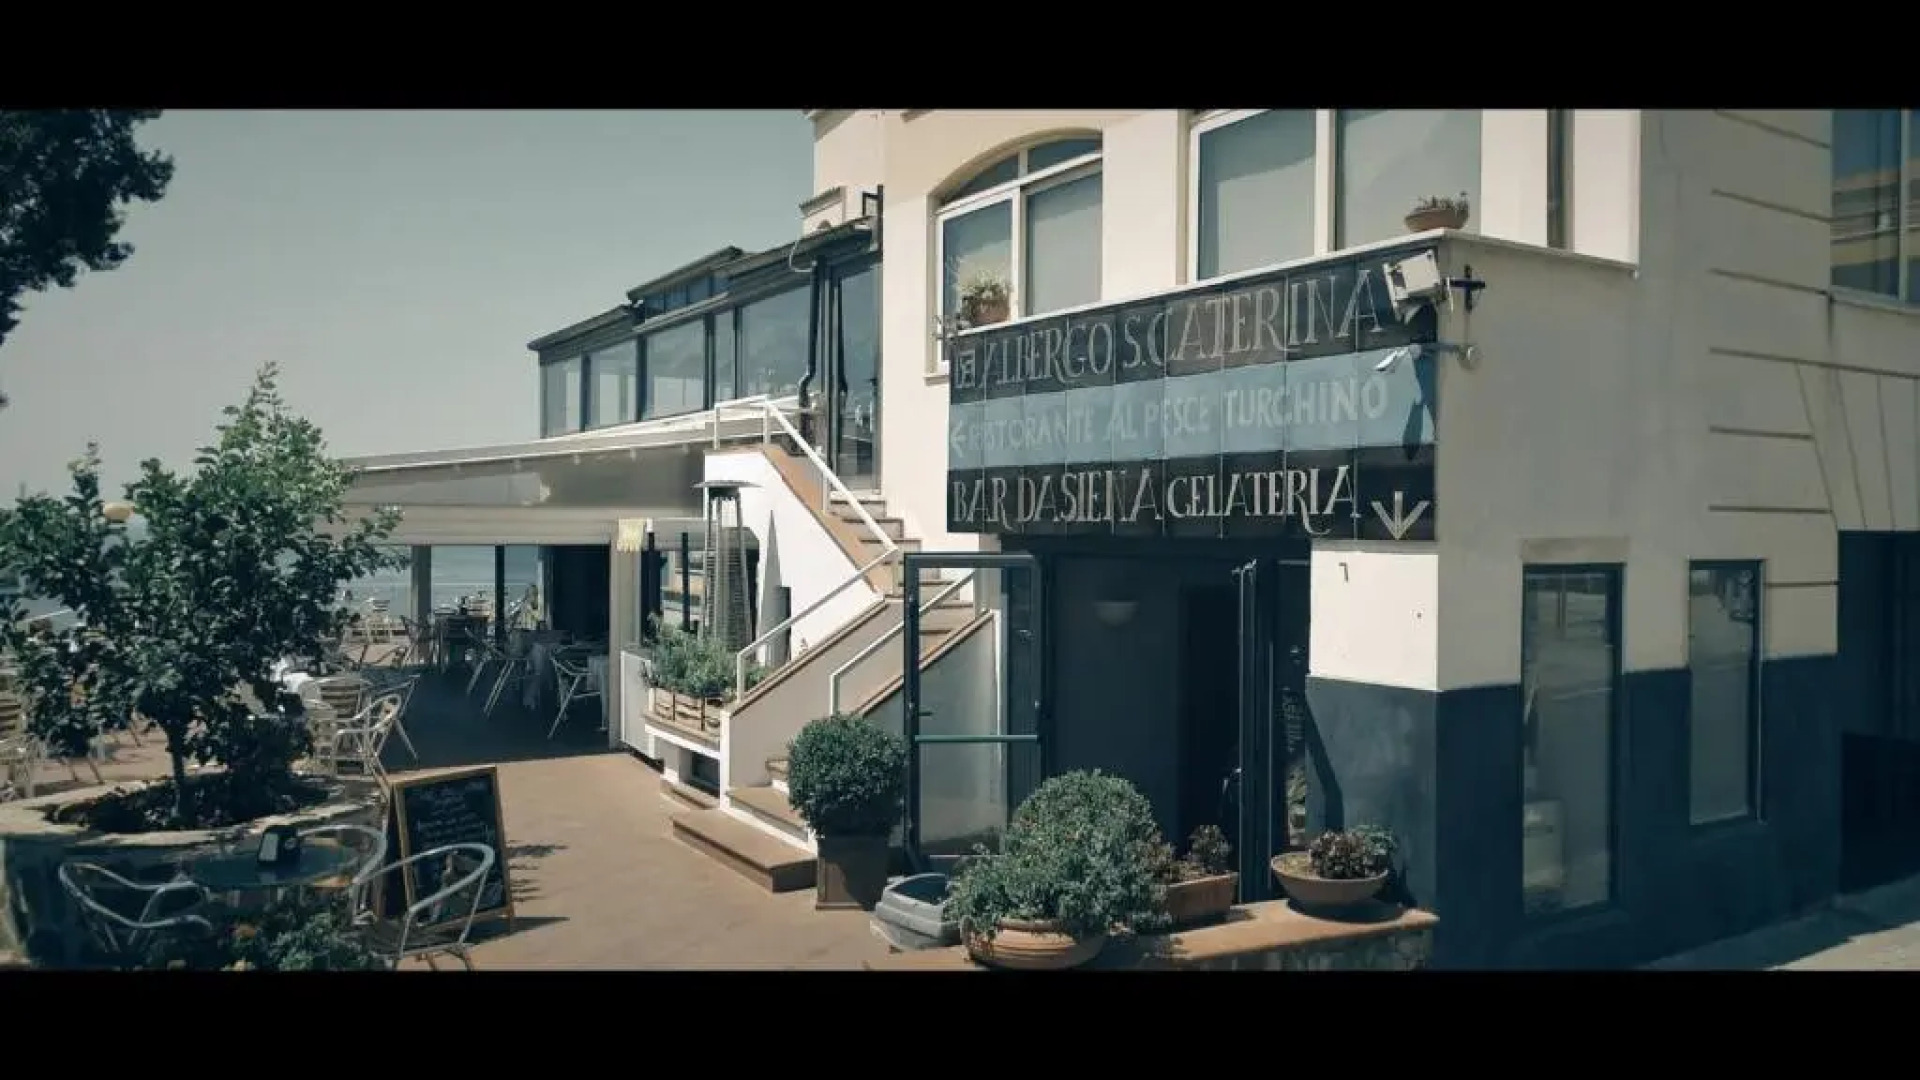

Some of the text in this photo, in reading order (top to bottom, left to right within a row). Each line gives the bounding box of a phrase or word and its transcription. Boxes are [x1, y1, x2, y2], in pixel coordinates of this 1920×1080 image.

[978, 322, 1113, 388] ALBERGO
[968, 375, 1388, 450] RISTORANTE AL PESCE TURCHINO
[953, 476, 1018, 533] BAR
[1167, 464, 1361, 535] GELATERIA
